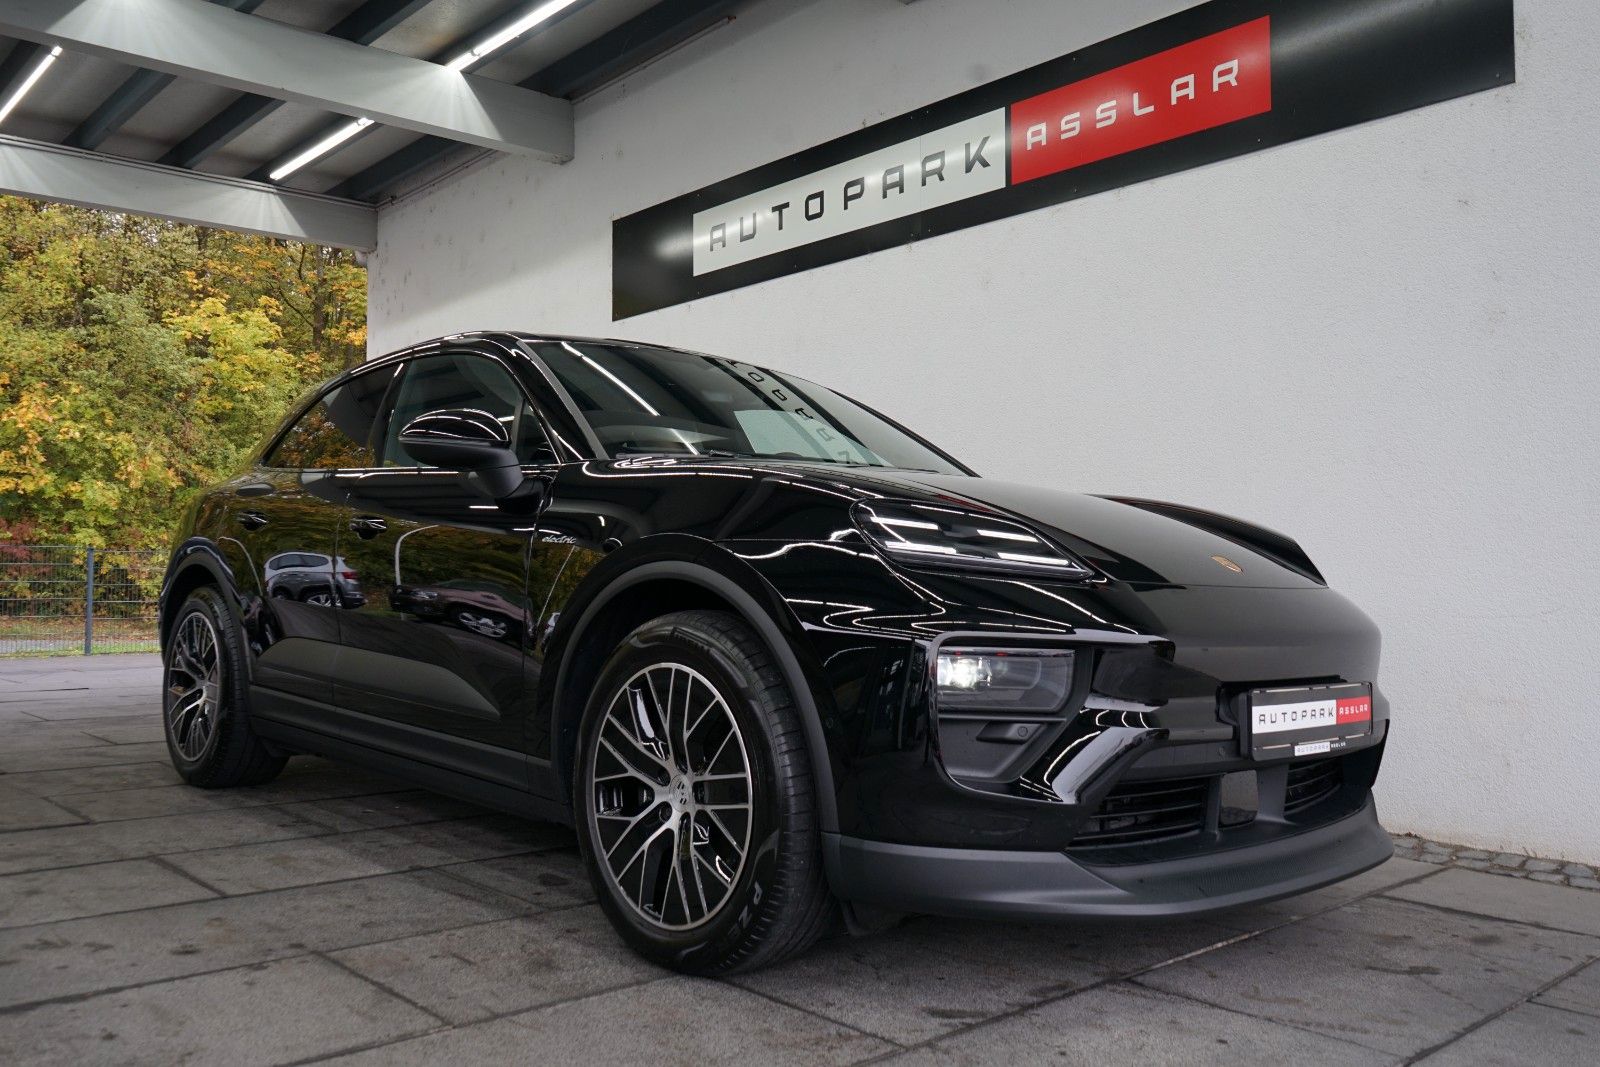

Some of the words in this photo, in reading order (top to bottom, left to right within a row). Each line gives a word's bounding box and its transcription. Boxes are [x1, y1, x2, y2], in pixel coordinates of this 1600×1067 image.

[709, 136, 991, 252] AUTOPARK
[1026, 59, 1239, 150] ASSLAR
[1258, 707, 1334, 725] AUTOPARK
[1339, 704, 1368, 715] ASSLAR
